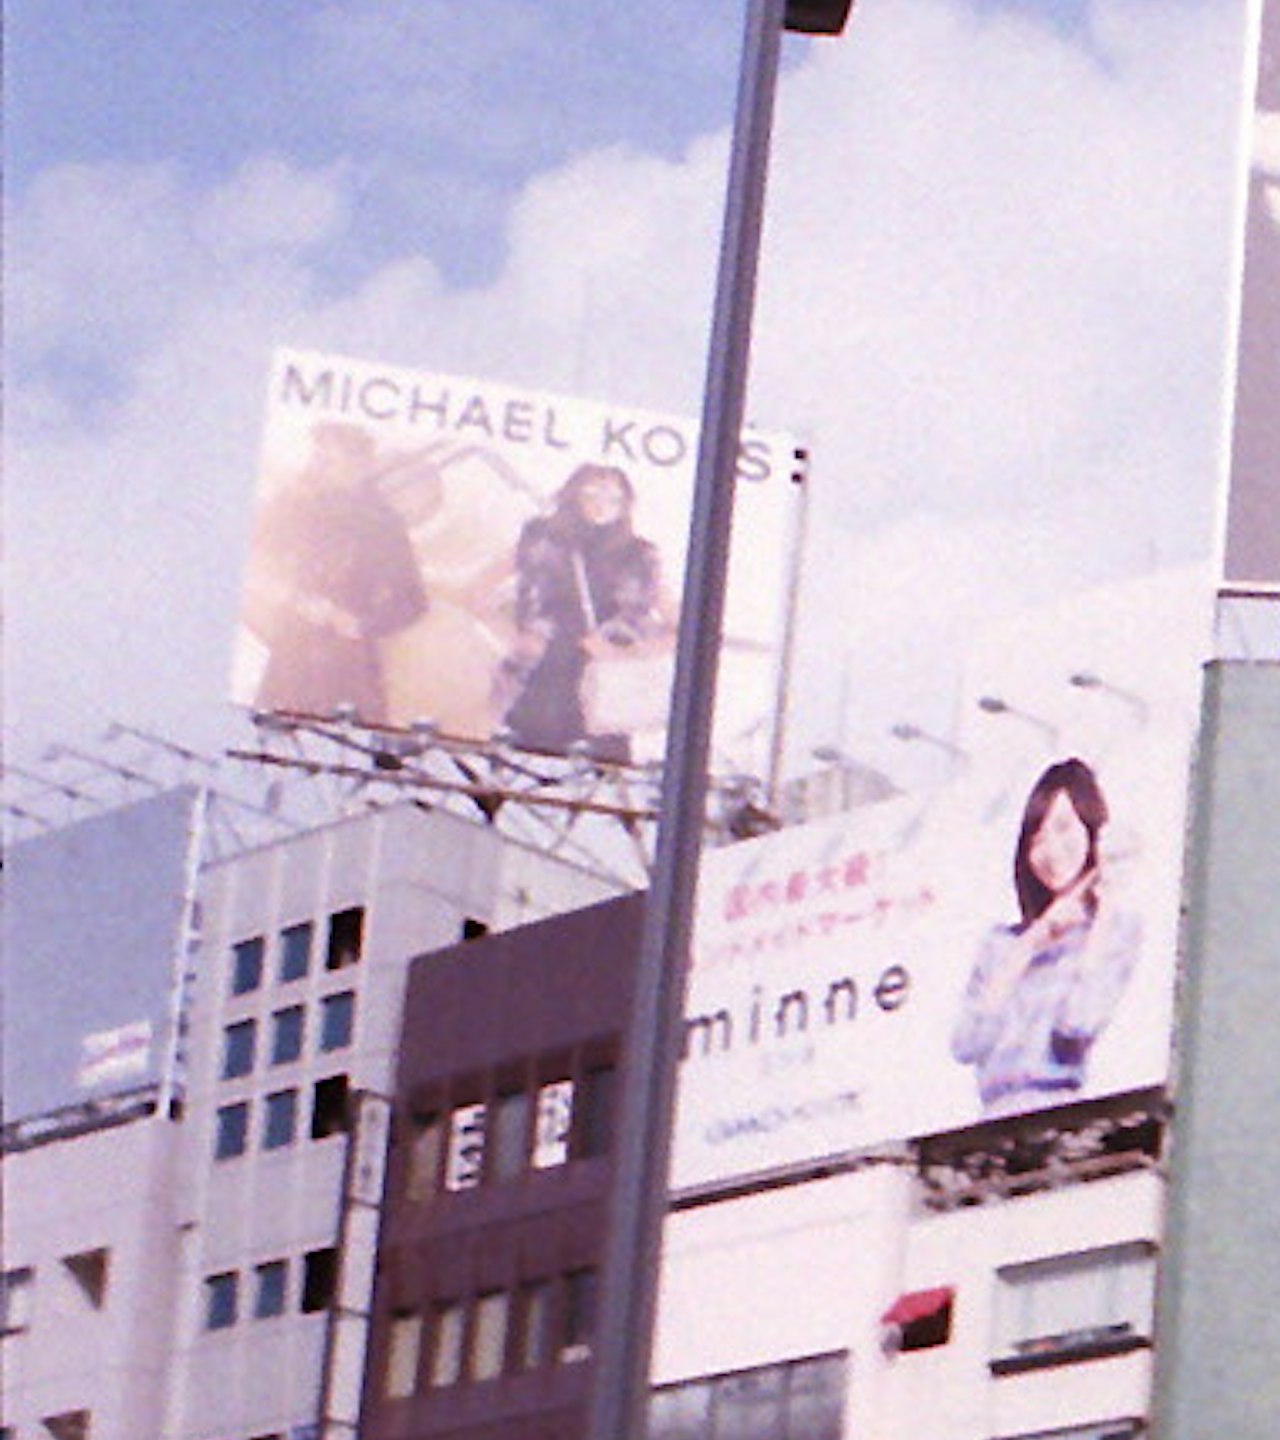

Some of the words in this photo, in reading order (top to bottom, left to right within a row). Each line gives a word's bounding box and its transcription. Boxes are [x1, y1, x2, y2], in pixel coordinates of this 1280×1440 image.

[281, 364, 569, 448] MICHAEL
[602, 418, 772, 482] KOS
[682, 964, 910, 1056] minne
